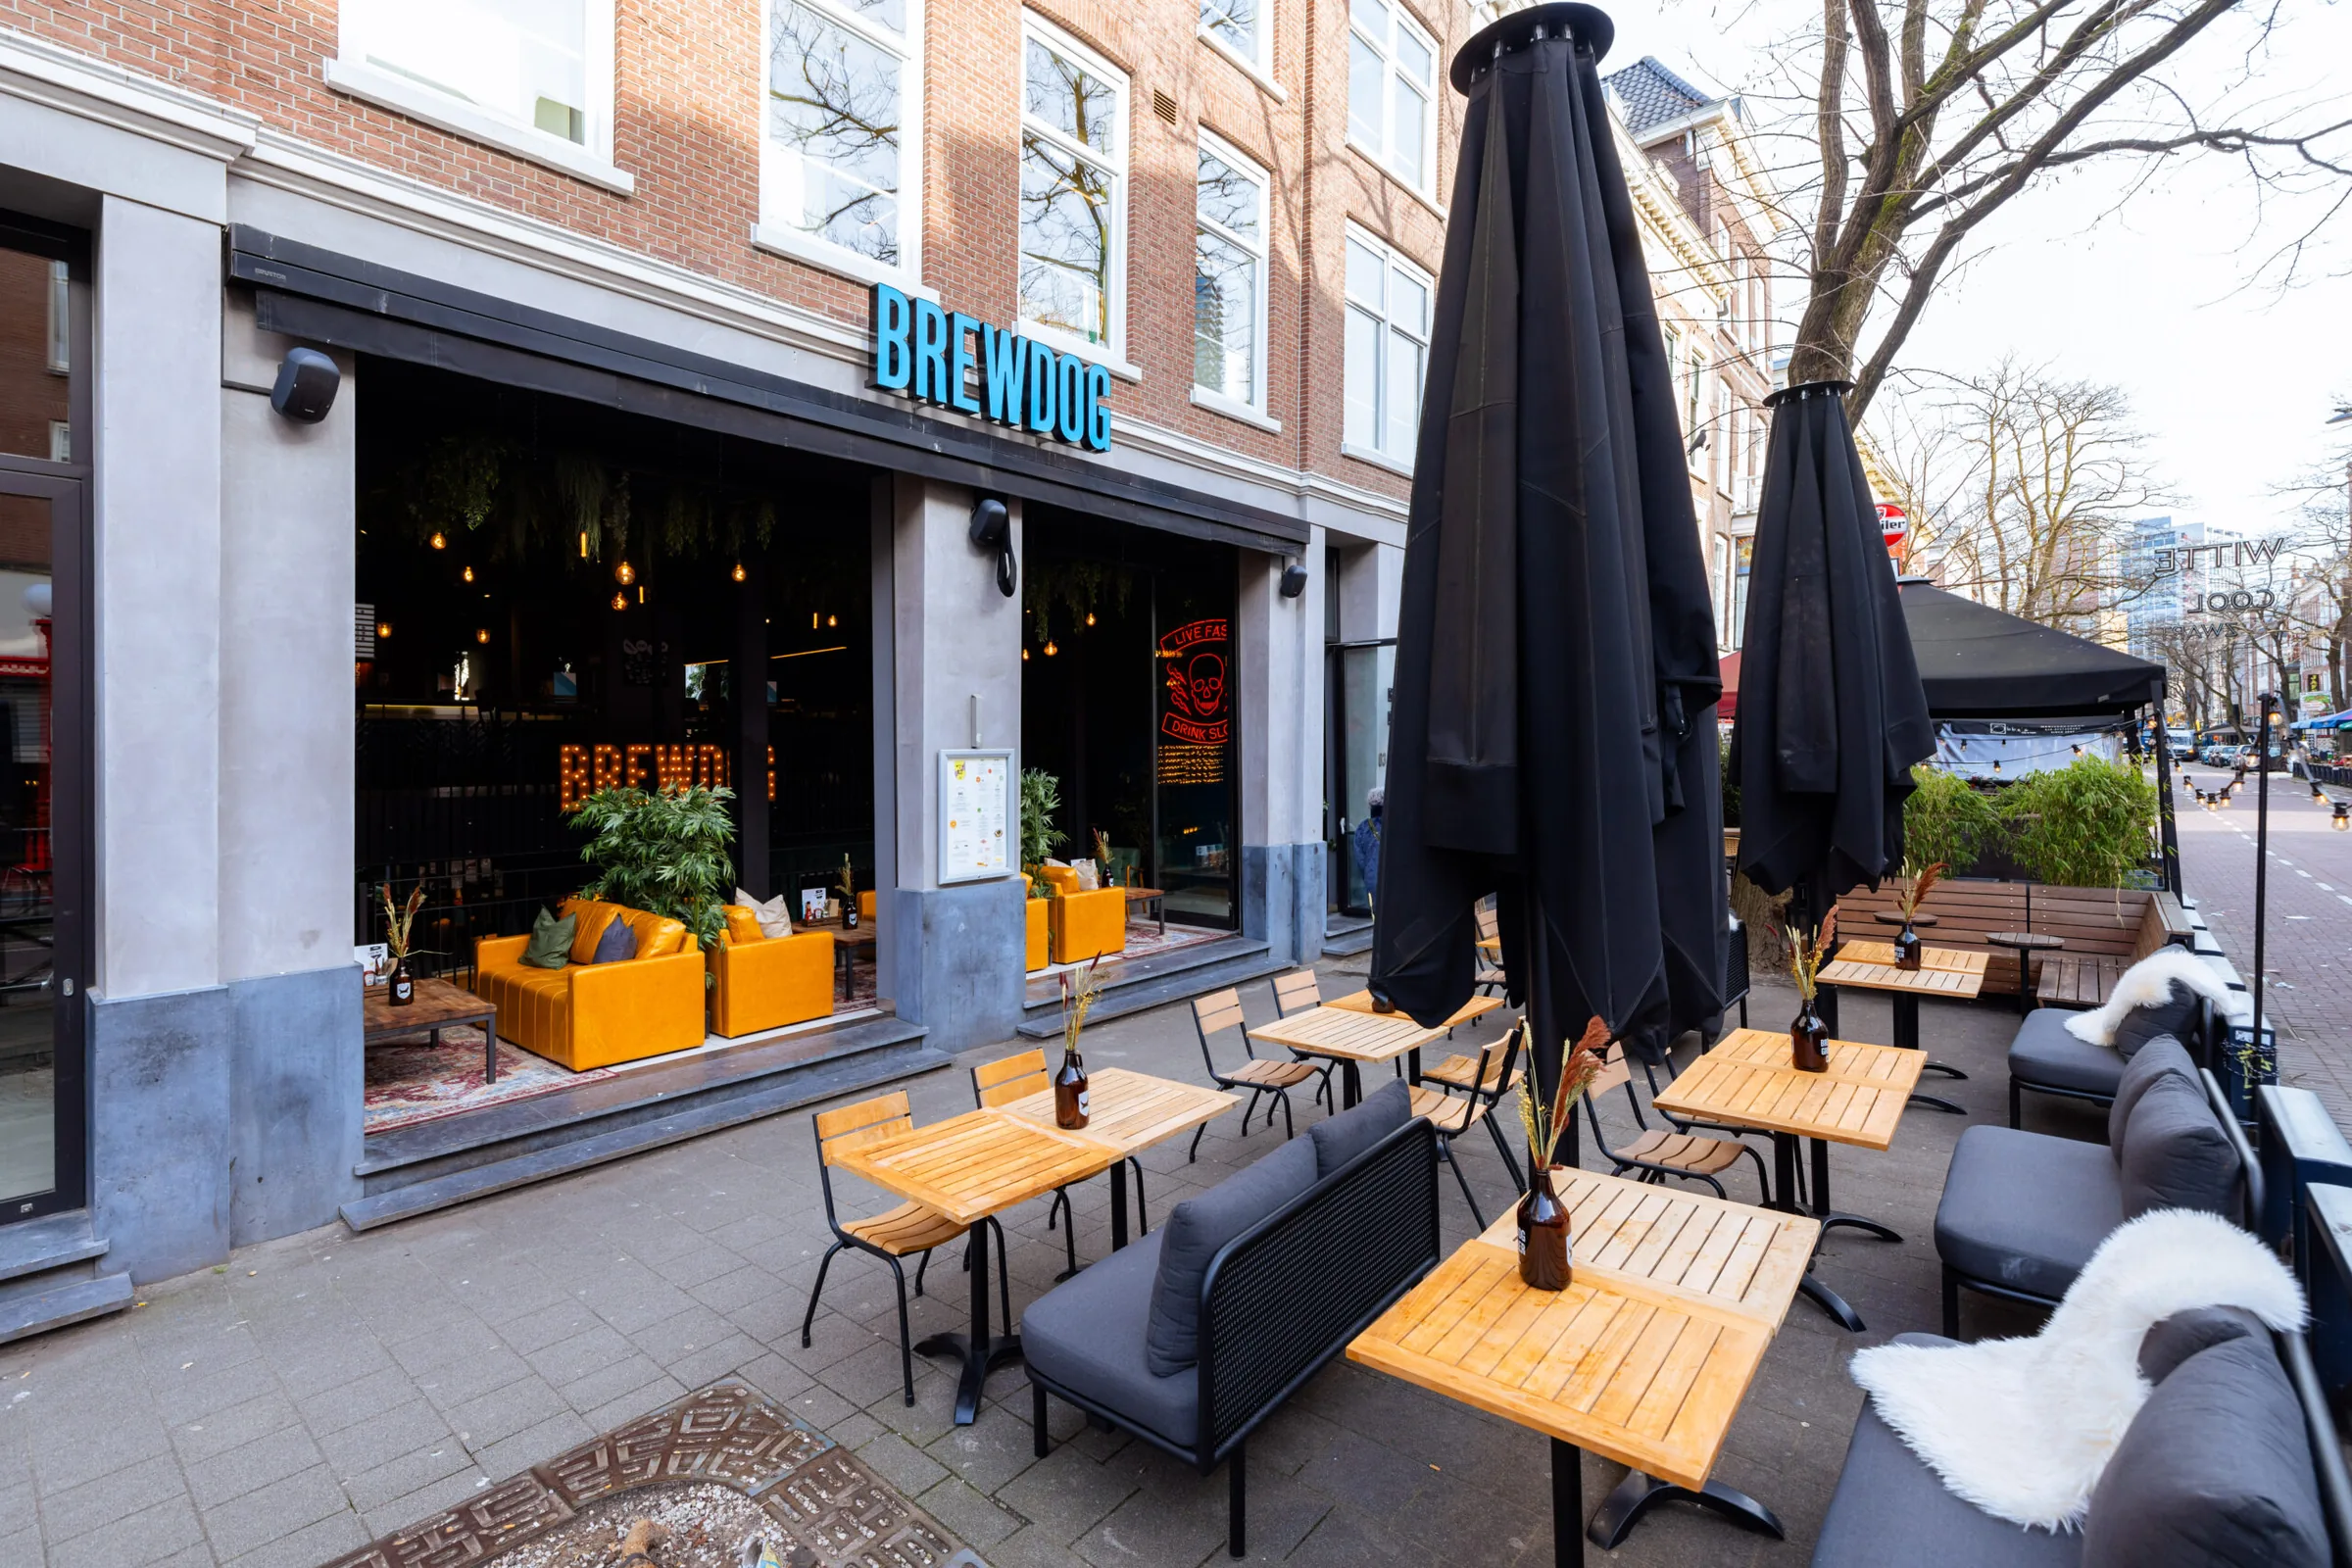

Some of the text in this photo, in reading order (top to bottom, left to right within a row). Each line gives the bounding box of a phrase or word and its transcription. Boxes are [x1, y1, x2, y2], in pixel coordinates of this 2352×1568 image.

[876, 281, 1112, 453] BREWDOG
[1175, 626, 1202, 645] LIVE
[1172, 720, 1206, 741] DRINK
